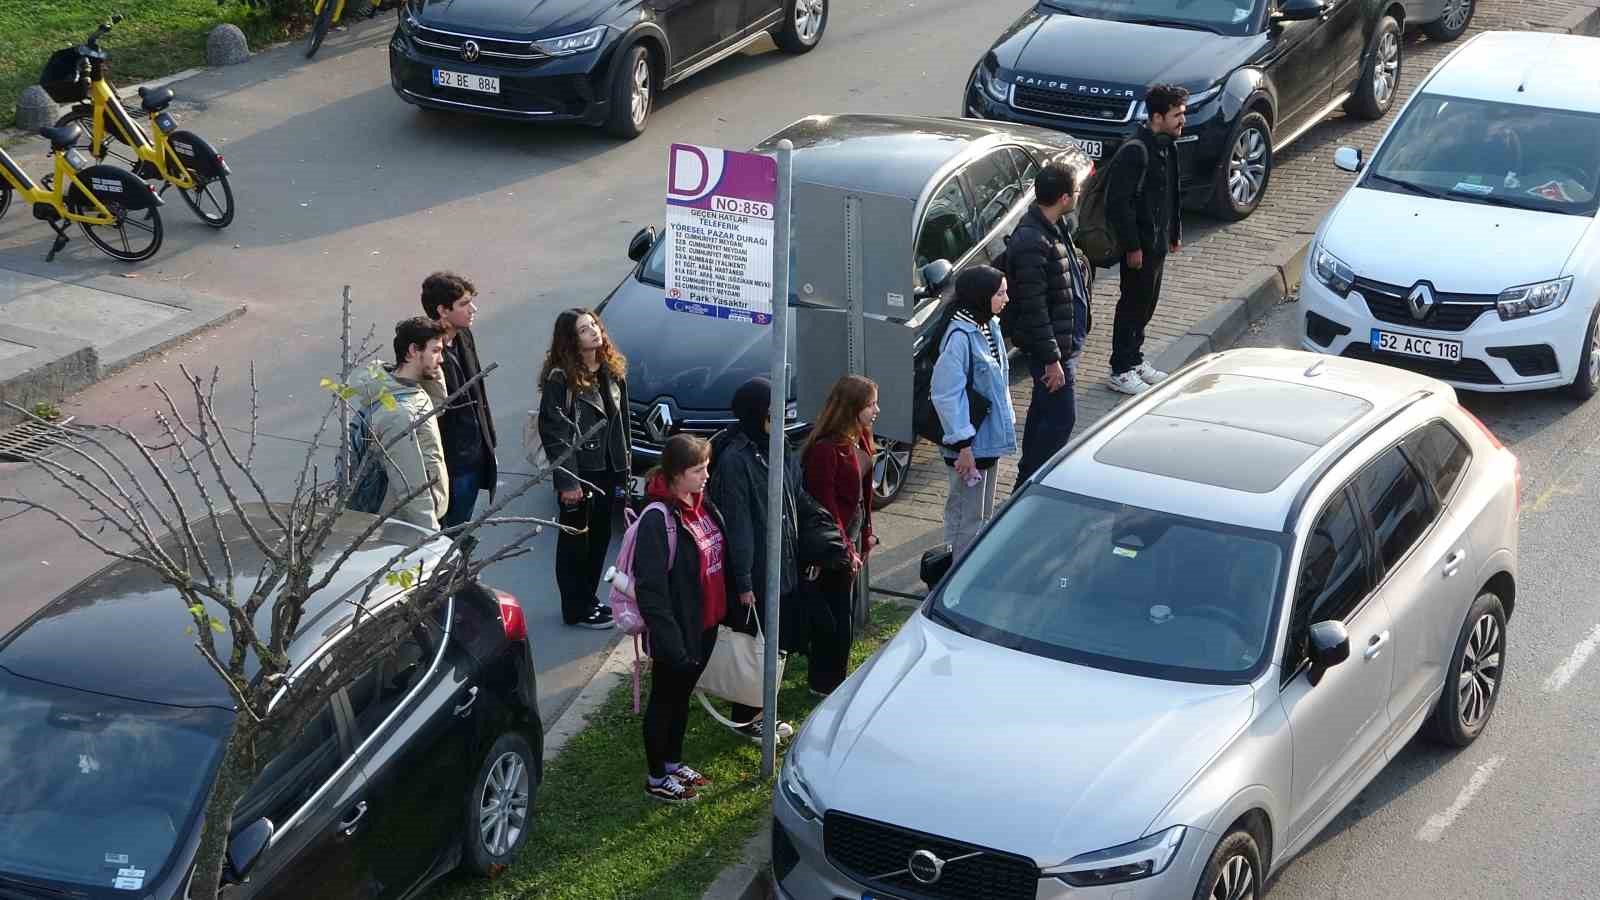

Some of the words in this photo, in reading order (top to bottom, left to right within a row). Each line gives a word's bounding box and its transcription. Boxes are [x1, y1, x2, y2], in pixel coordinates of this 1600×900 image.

[440, 71, 451, 85] 52
[457, 74, 469, 88] BE
[478, 78, 497, 91] 884
[668, 143, 710, 197] D
[716, 197, 768, 217] NO:856
[718, 212, 749, 224] HATLAR
[671, 222, 705, 236] YÖRESEL
[707, 229, 736, 241] PAZAR
[689, 291, 709, 303] Park
[1380, 333, 1398, 350] 52
[1403, 337, 1432, 355] ACC
[1438, 342, 1459, 359] 118
